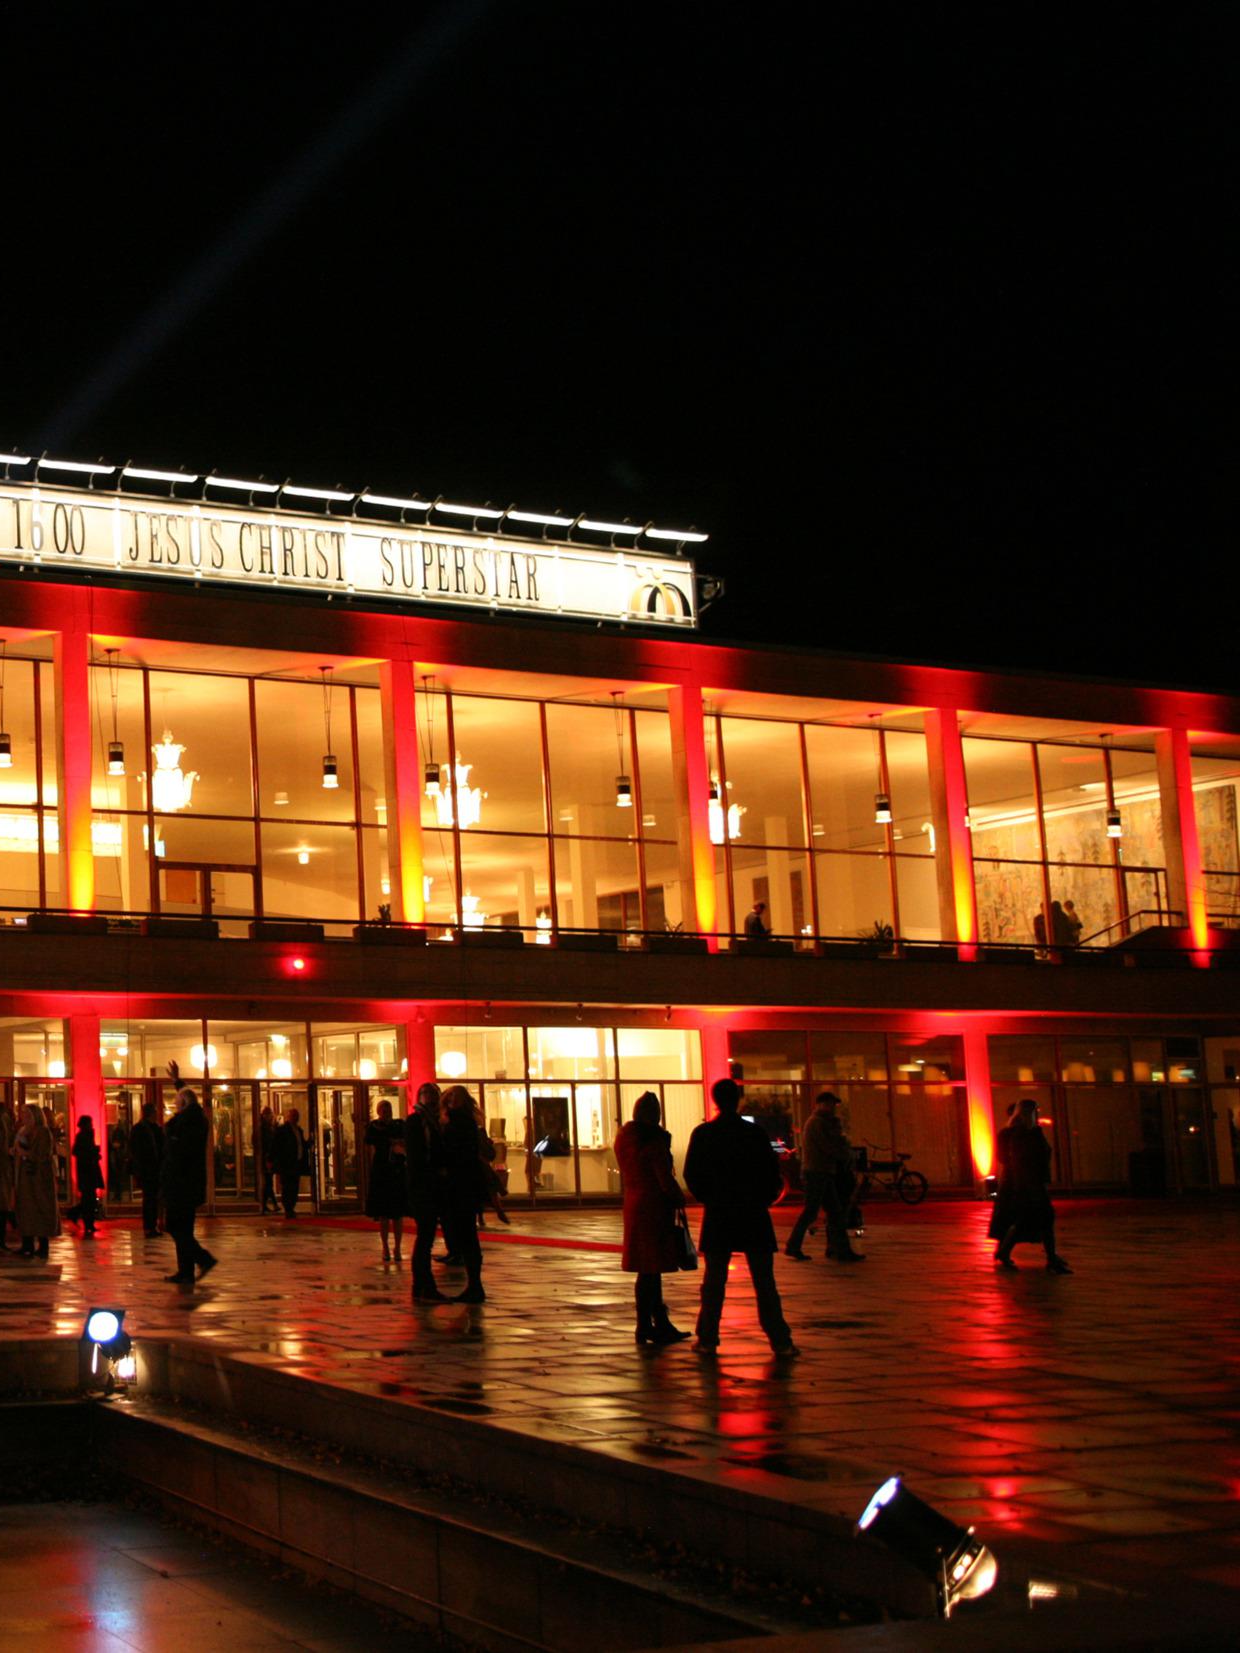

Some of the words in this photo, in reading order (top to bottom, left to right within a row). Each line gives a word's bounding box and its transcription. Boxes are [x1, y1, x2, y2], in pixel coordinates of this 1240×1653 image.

[129, 511, 224, 569] JESUS
[239, 522, 345, 581] CHRIST
[380, 537, 540, 601] SUPERSTAR
